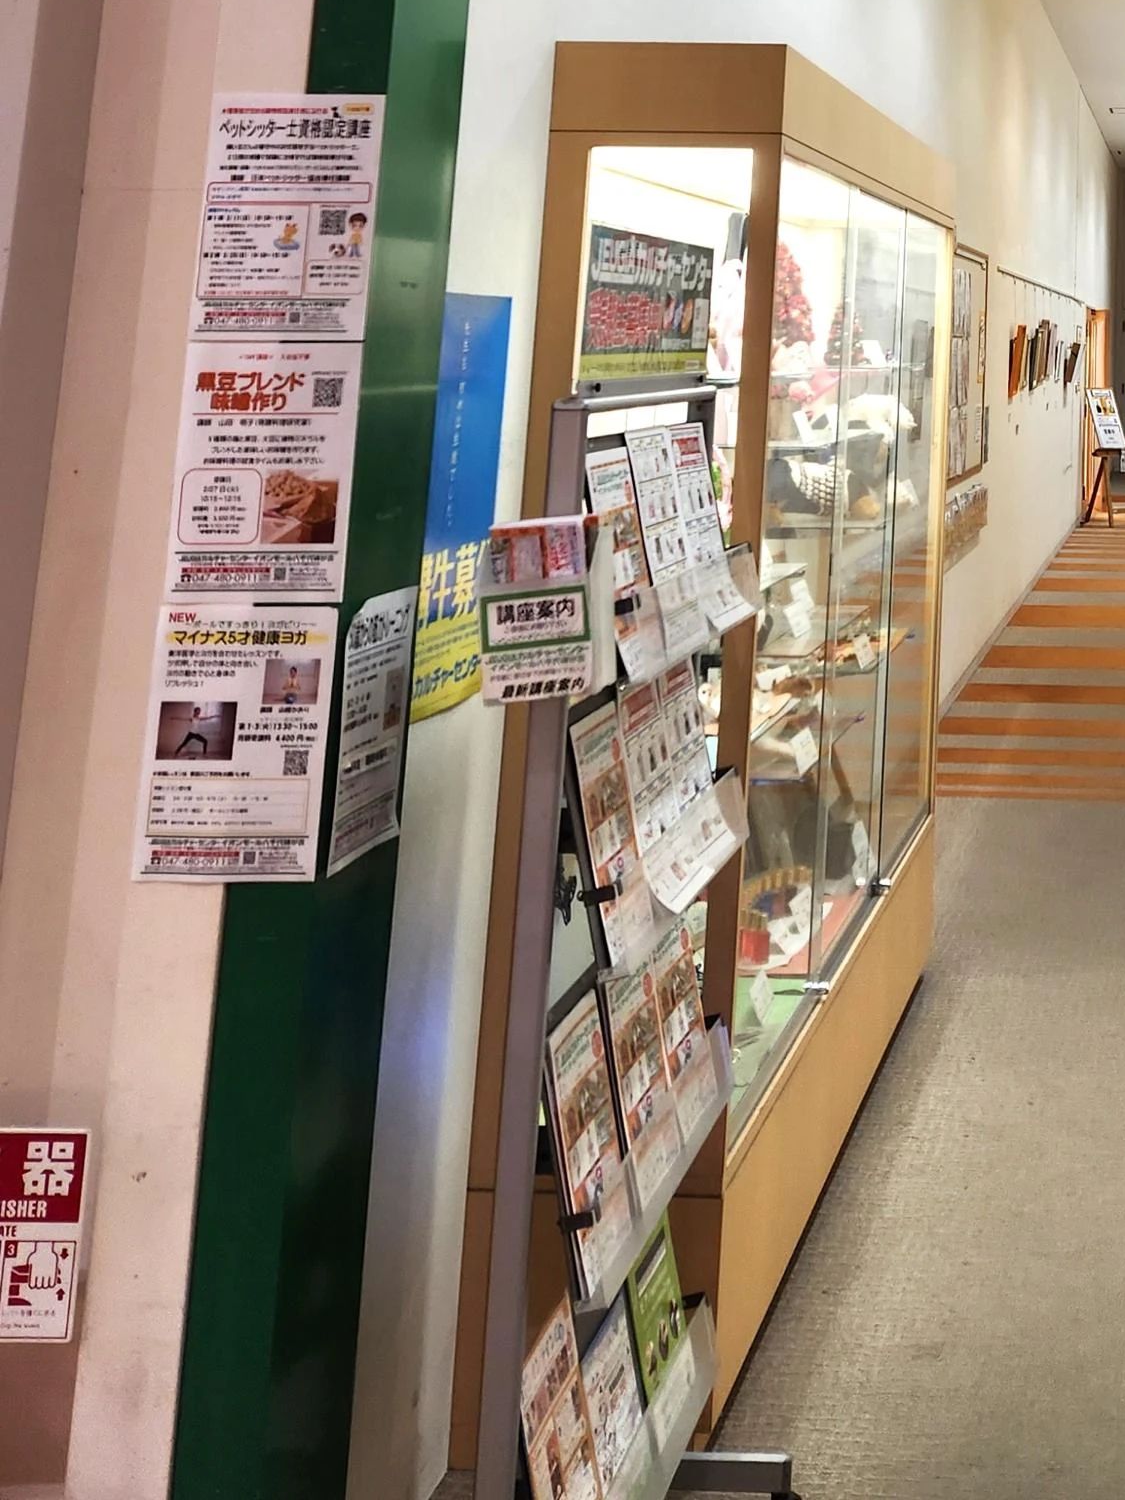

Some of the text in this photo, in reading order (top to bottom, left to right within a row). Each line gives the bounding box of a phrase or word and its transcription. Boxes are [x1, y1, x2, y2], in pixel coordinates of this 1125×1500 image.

[219, 119, 372, 139] ペットシッター士資格認定講座
[196, 371, 305, 392] 黒豆ブレンド
[211, 393, 287, 411] 味噌作り
[169, 612, 196, 623] NEW
[497, 598, 575, 625] 講座案内
[173, 631, 307, 645] マイナス5才健康ヨガ
[22, 1141, 75, 1196] 器
[7, 1244, 15, 1255] 3
